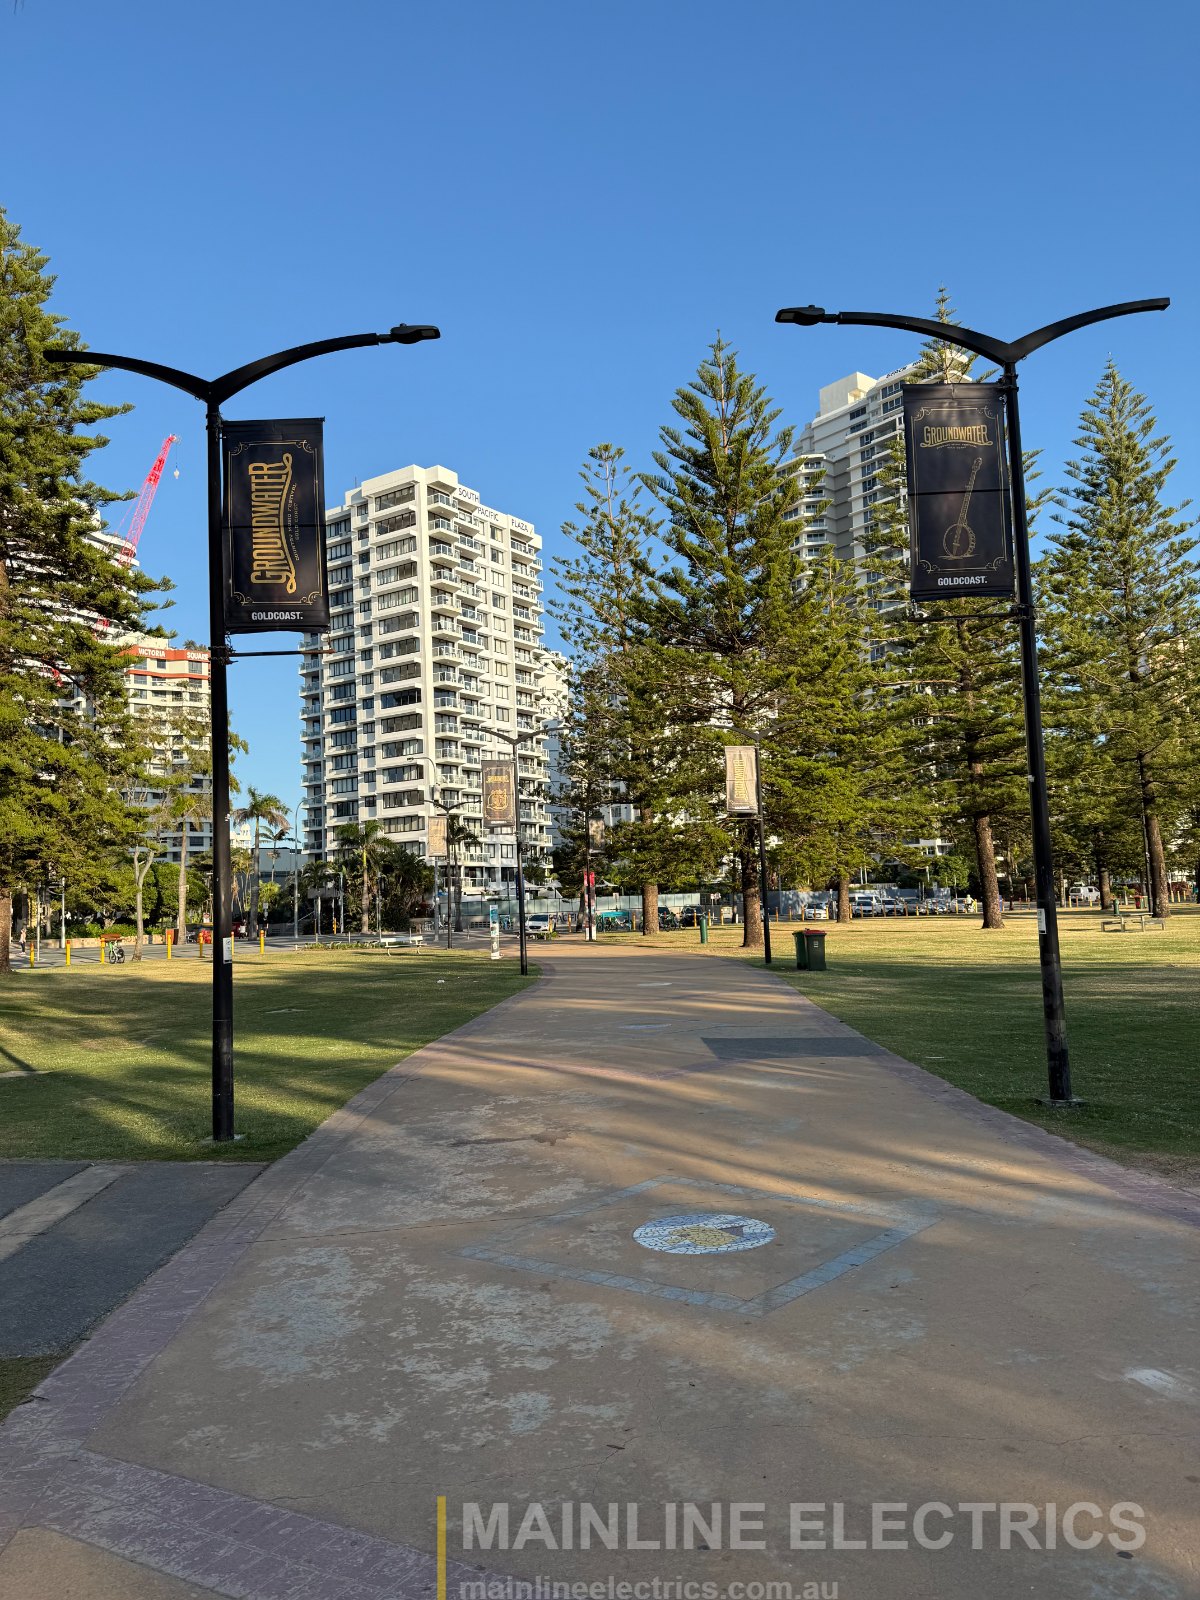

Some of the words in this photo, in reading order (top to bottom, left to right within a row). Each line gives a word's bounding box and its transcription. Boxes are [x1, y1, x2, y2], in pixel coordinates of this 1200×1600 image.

[922, 424, 990, 446] GROUNDWATER
[248, 458, 294, 588] GROUNDWATER
[458, 487, 479, 502] SOUTH
[477, 506, 500, 522] PACIFIC
[511, 518, 529, 533] PLAZA
[138, 648, 166, 658] VICTORIA
